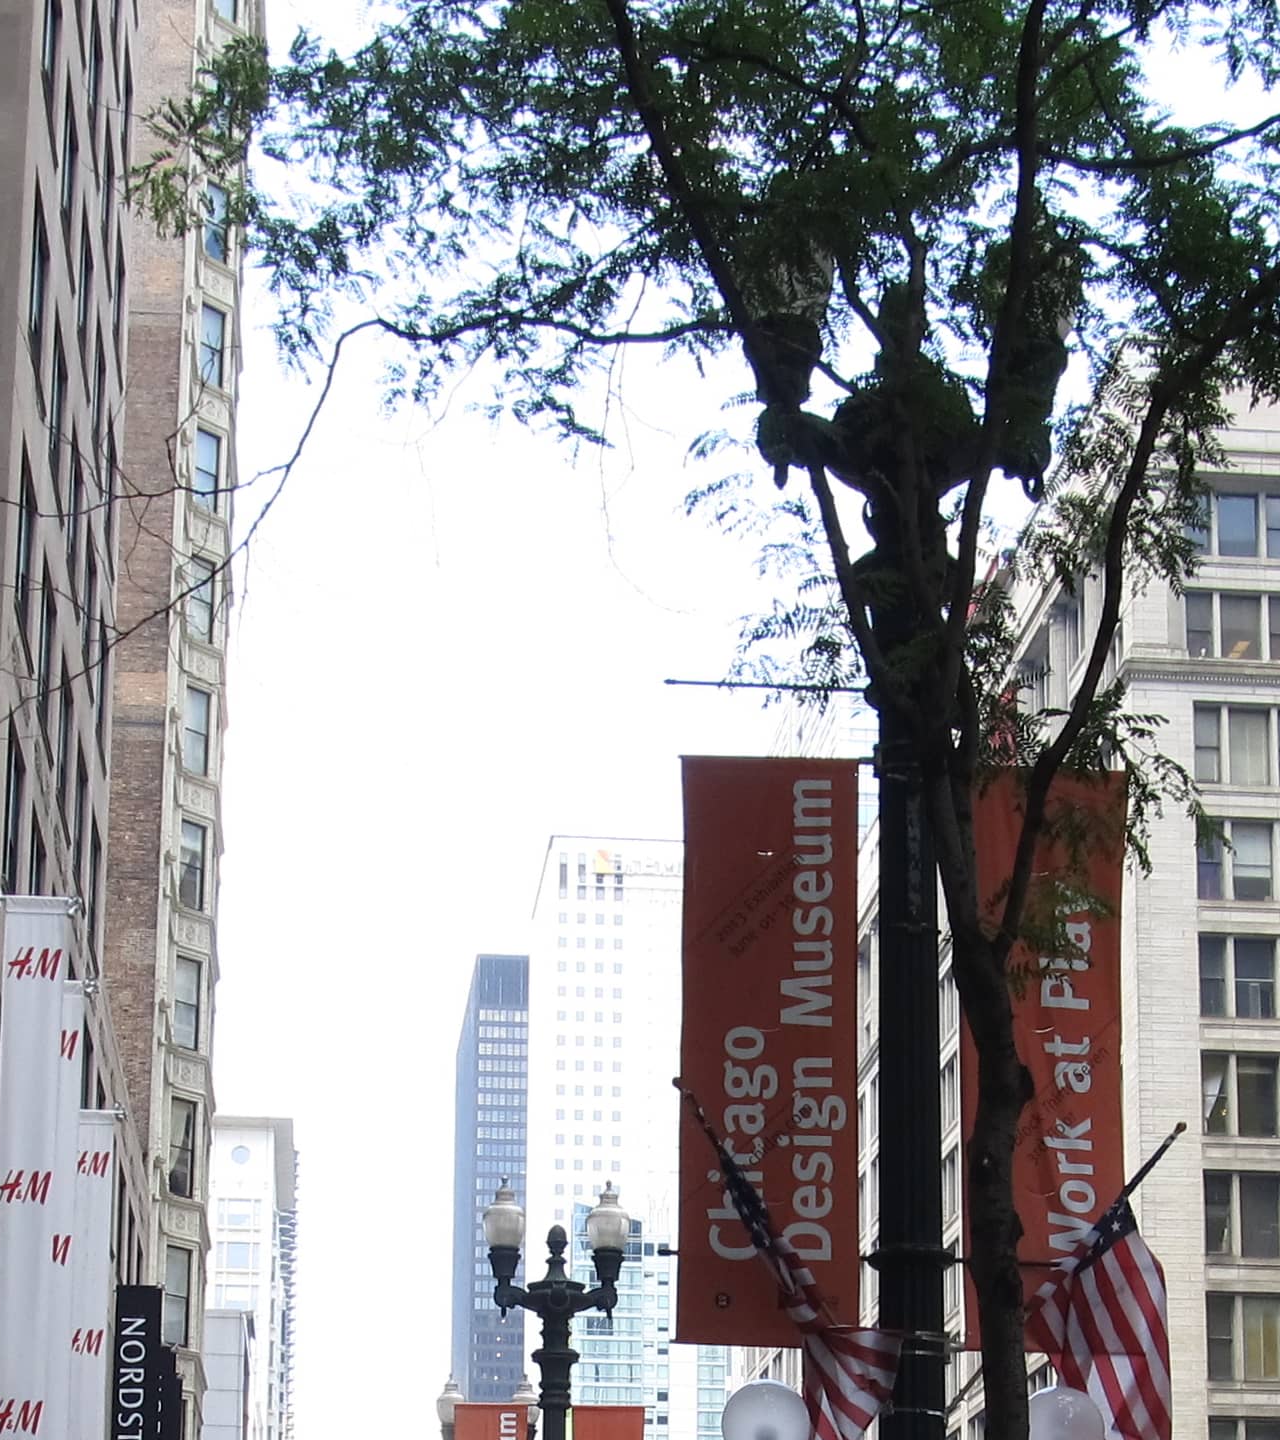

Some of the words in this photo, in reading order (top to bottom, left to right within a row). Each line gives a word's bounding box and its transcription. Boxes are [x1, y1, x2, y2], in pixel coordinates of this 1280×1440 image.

[7, 946, 63, 982] H&M
[780, 779, 833, 1027] Museum
[1043, 1035, 1092, 1094] at
[777, 1057, 847, 1261] Design
[1043, 1117, 1097, 1268] Work
